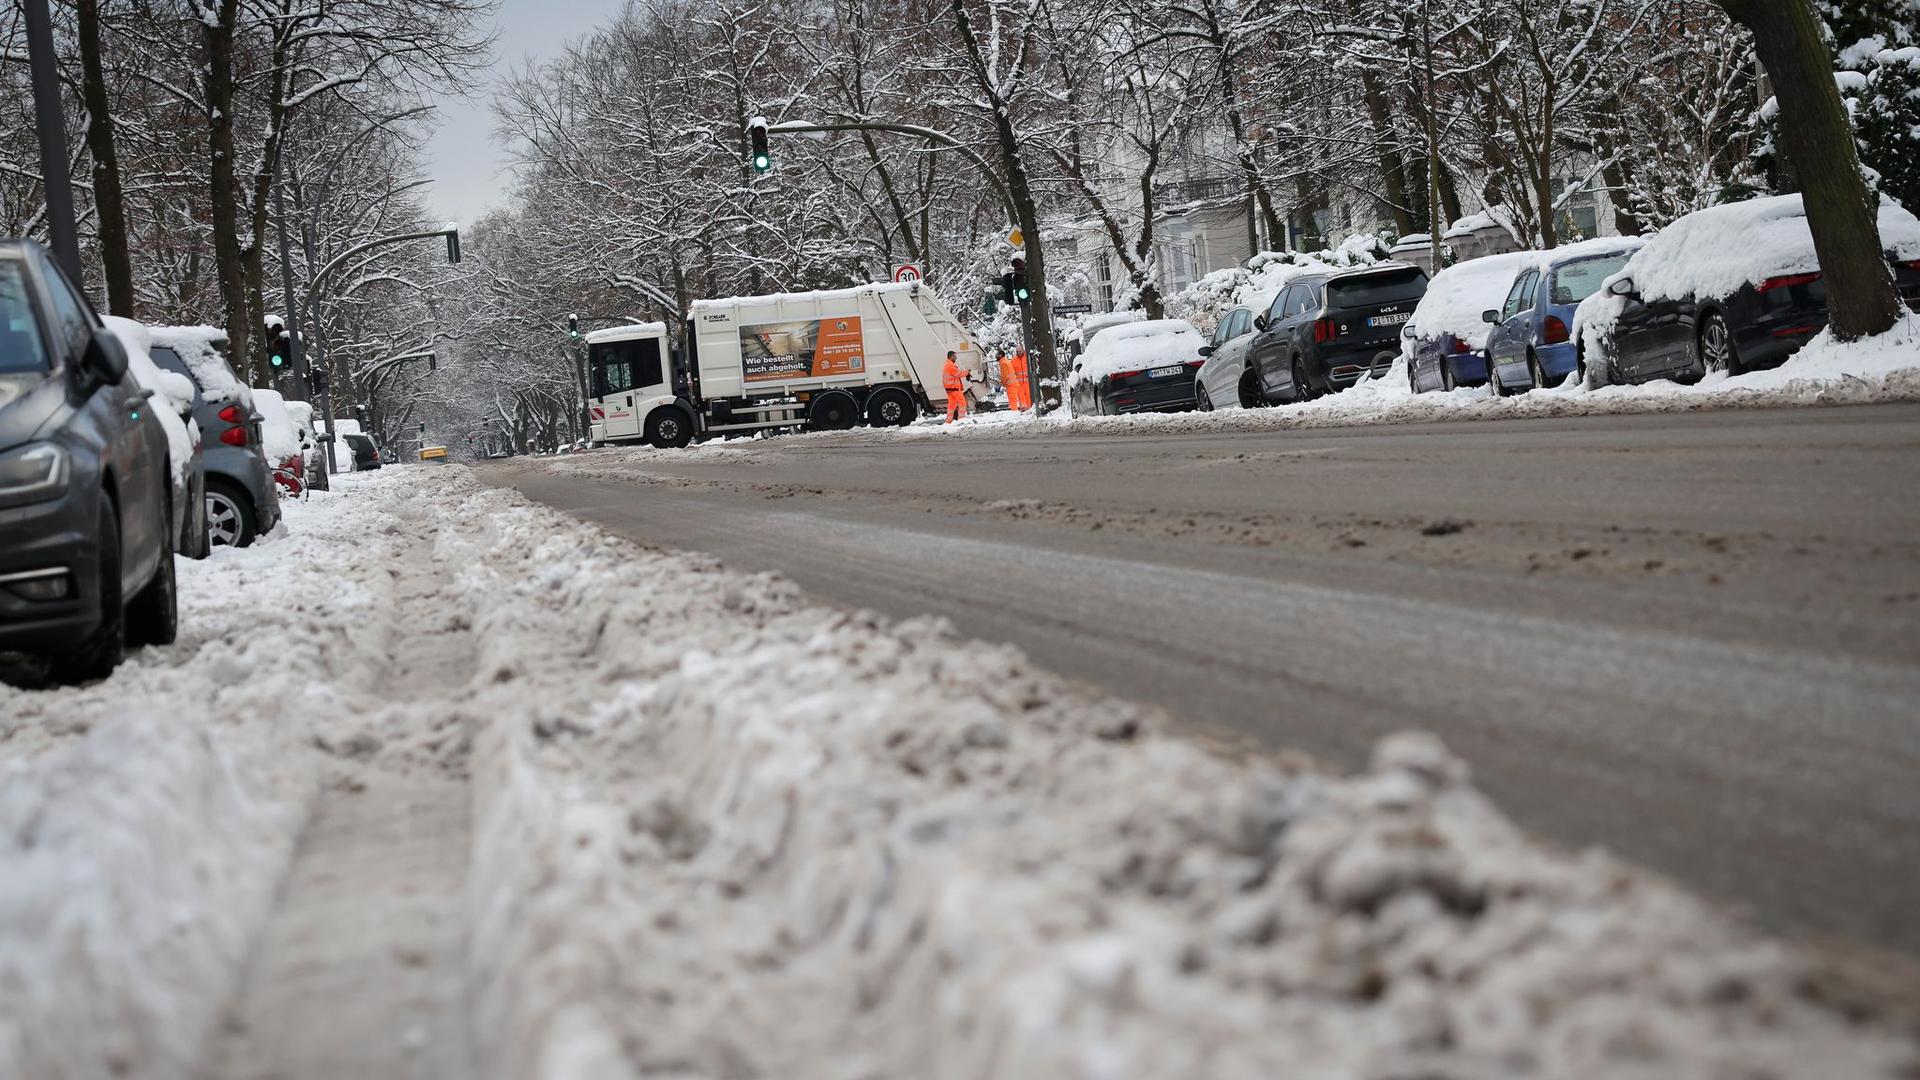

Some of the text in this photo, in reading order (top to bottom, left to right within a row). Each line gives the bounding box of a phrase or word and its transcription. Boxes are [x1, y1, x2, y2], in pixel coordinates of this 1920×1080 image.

[1380, 305, 1398, 313] KIA
[1372, 313, 1410, 325] PI TB 333
[745, 354, 794, 365] Wie bestellt
[746, 362, 807, 374] auch abgeholt.
